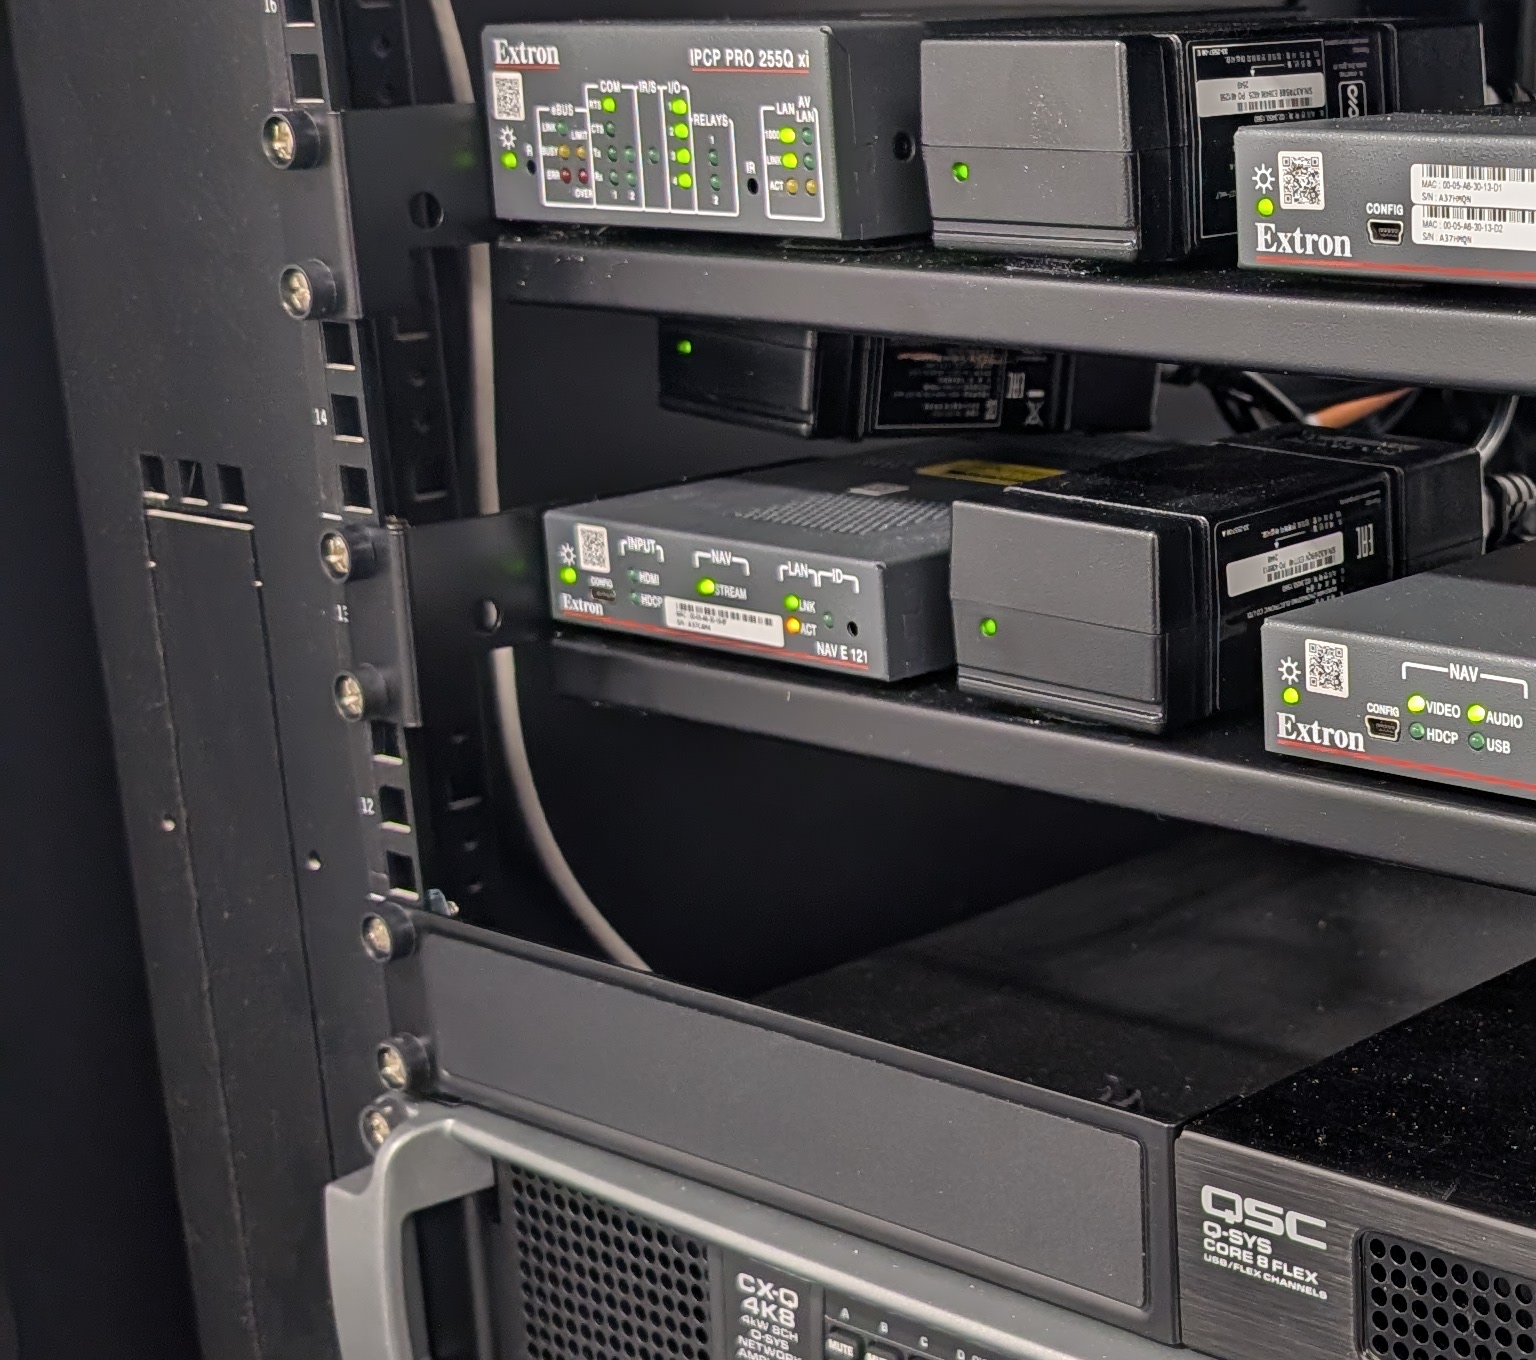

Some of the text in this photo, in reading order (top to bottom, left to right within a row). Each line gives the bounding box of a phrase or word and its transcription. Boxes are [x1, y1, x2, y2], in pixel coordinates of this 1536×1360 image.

[495, 39, 560, 65] Extron
[690, 48, 810, 68] IPCP PRO 255Q xi
[600, 80, 621, 93] COM
[639, 81, 657, 94] IR/S
[667, 82, 681, 94] I/O
[551, 103, 574, 117] eBUS
[776, 103, 795, 116] LAN
[796, 96, 815, 123] AV LAN
[694, 114, 729, 128] RELAYS
[746, 161, 756, 175] IR
[769, 181, 784, 191] ACT
[1422, 180, 1437, 189] MAC
[1366, 202, 1404, 216] CONFIG
[1423, 220, 1437, 229] MAC
[1255, 222, 1353, 258] Extron
[313, 407, 327, 426] 14
[628, 536, 656, 554] INPUT
[711, 550, 732, 565] NAV
[787, 561, 808, 577] LAN
[832, 568, 843, 583] ID
[641, 593, 663, 608] HDCP
[715, 584, 747, 601] STREAM
[560, 592, 605, 616] Extron
[799, 599, 816, 614] LNK
[801, 624, 817, 637] ACT
[815, 641, 868, 664] NAV E 121
[1449, 663, 1479, 682] NAV
[1367, 702, 1400, 718] CONFIG
[1426, 700, 1461, 719] VIDEO
[1486, 710, 1523, 729] AUDIO
[1276, 712, 1366, 752] Extron
[1427, 727, 1459, 745] HDCP
[1486, 738, 1511, 754] USB
[361, 797, 375, 815] 12
[1201, 1184, 1327, 1250] QSC
[1203, 1221, 1272, 1254] Q-SYS
[1203, 1238, 1318, 1285] CORE 8 FLEX
[1203, 1253, 1327, 1300] USB/FLEX CHANNELS
[736, 1272, 798, 1309] CX-Q
[742, 1297, 795, 1328] 4K8
[839, 1307, 849, 1320] A
[741, 1315, 799, 1343] 4kW 8CH
[879, 1321, 888, 1334] B
[750, 1329, 789, 1350] Q-SYS
[827, 1338, 854, 1358] MUTE
[920, 1336, 928, 1348] C
